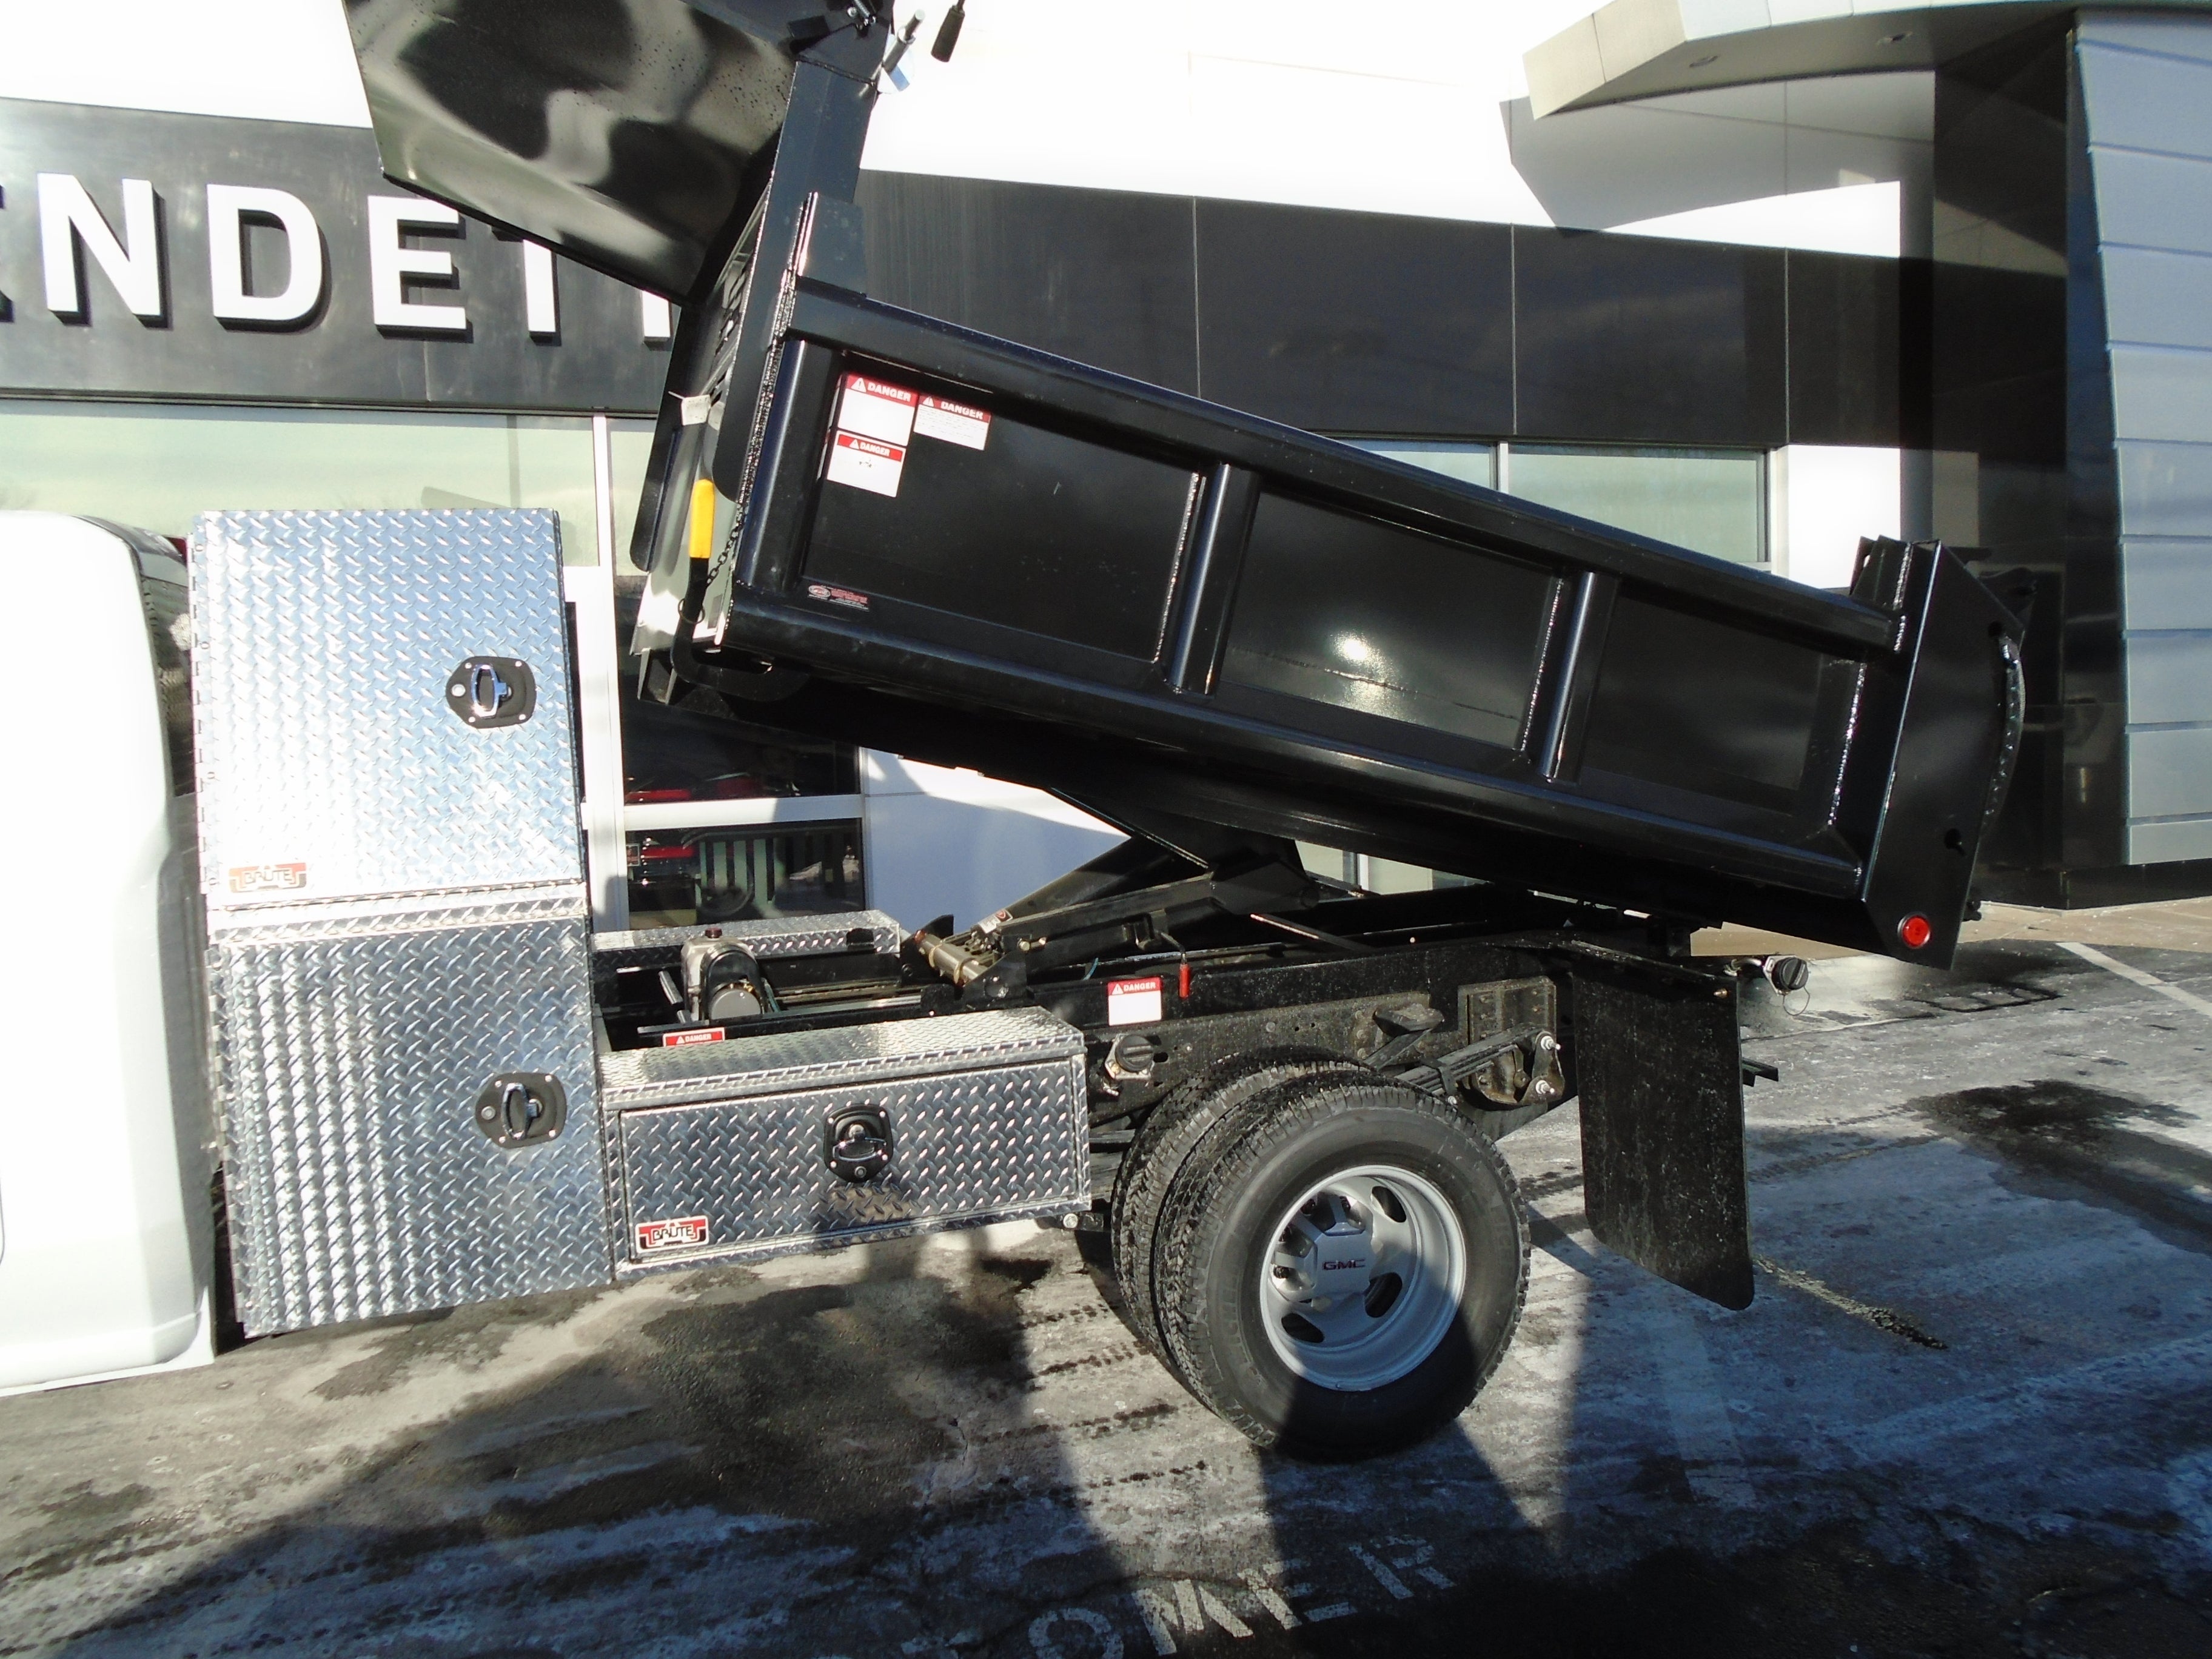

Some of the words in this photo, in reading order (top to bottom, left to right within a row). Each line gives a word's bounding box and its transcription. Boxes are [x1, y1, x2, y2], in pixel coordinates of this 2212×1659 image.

[868, 382, 911, 402] DANGER
[940, 401, 983, 420] DANGER
[860, 442, 890, 457] DANGER
[1123, 982, 1156, 991] DANGER
[685, 1033, 711, 1042] DANGER
[1322, 1259, 1366, 1270] GMC
